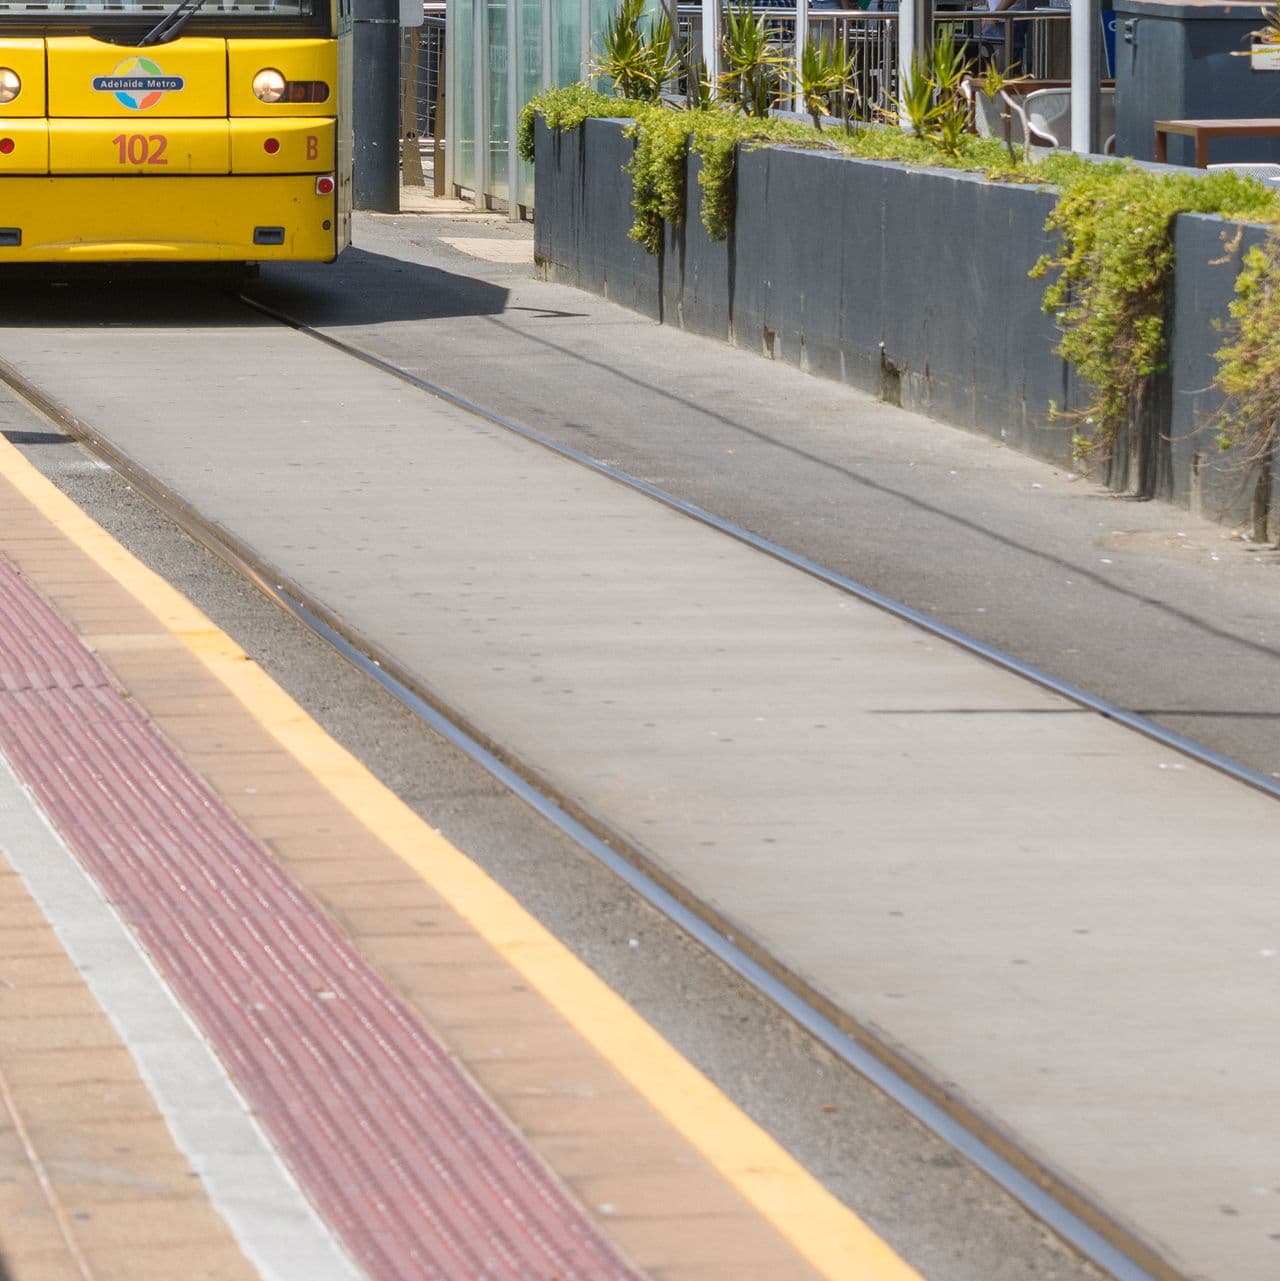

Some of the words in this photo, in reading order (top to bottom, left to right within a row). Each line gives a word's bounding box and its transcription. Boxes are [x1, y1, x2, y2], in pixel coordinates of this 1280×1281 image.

[100, 79, 144, 89] Adelaide
[147, 79, 177, 89] Metro
[112, 134, 169, 165] 102
[306, 135, 319, 161] B
